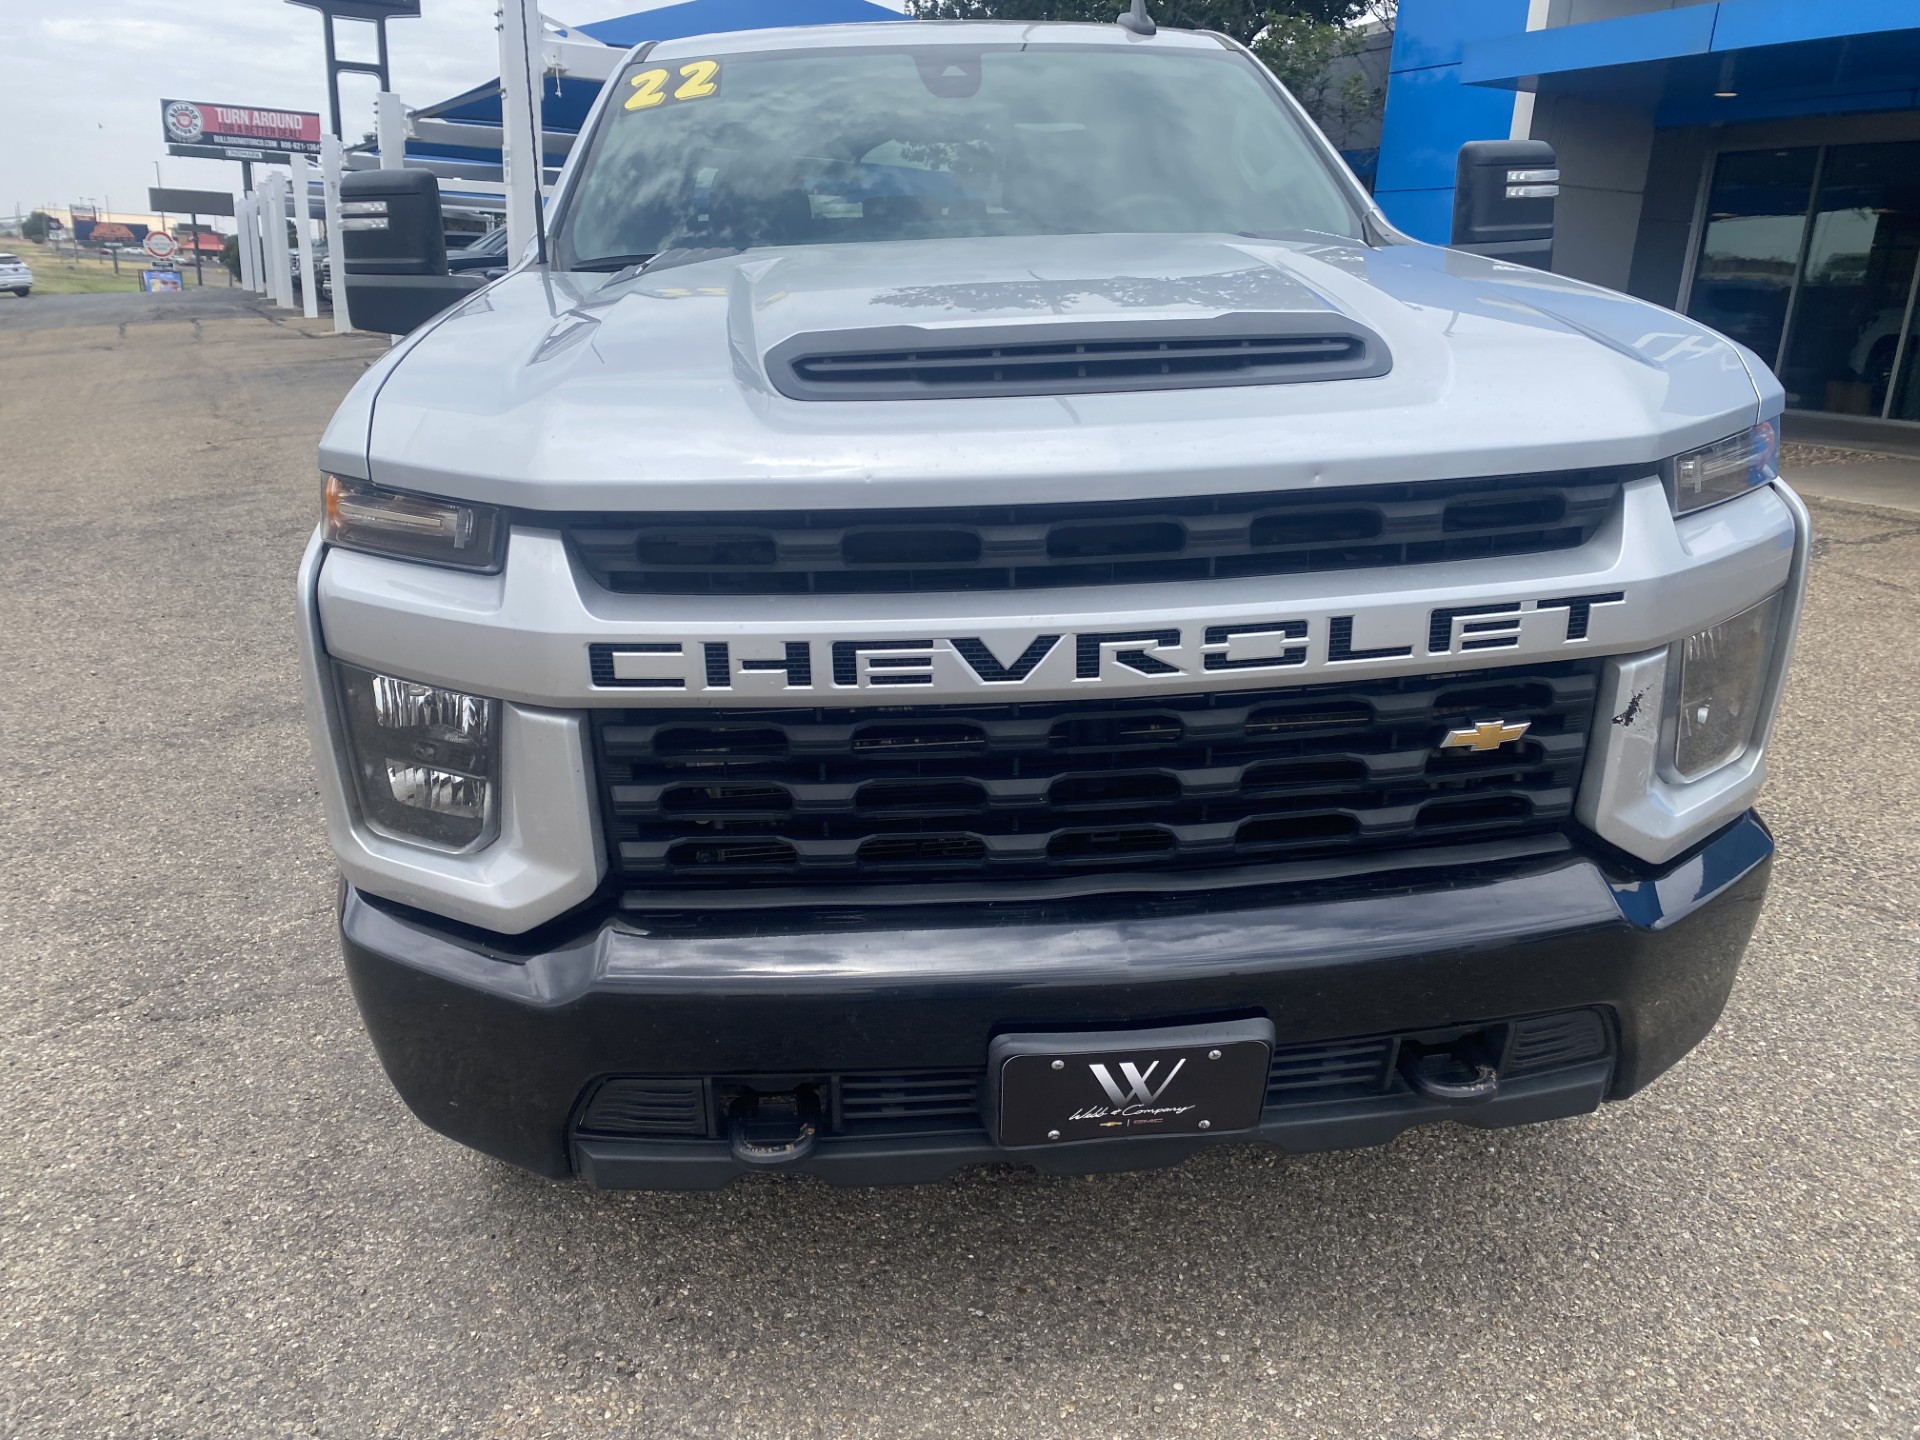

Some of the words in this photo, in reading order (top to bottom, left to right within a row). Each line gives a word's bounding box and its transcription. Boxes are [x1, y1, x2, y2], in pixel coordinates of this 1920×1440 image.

[624, 60, 719, 111] 22
[169, 104, 199, 119] BULLDOG
[215, 108, 249, 124] TURN
[252, 112, 303, 129] AROUND
[218, 123, 235, 133] FOR
[236, 125, 243, 134] A
[245, 126, 276, 137] BETTER
[587, 591, 1626, 691] CHEVROLET
[1122, 1103, 1196, 1117] Company
